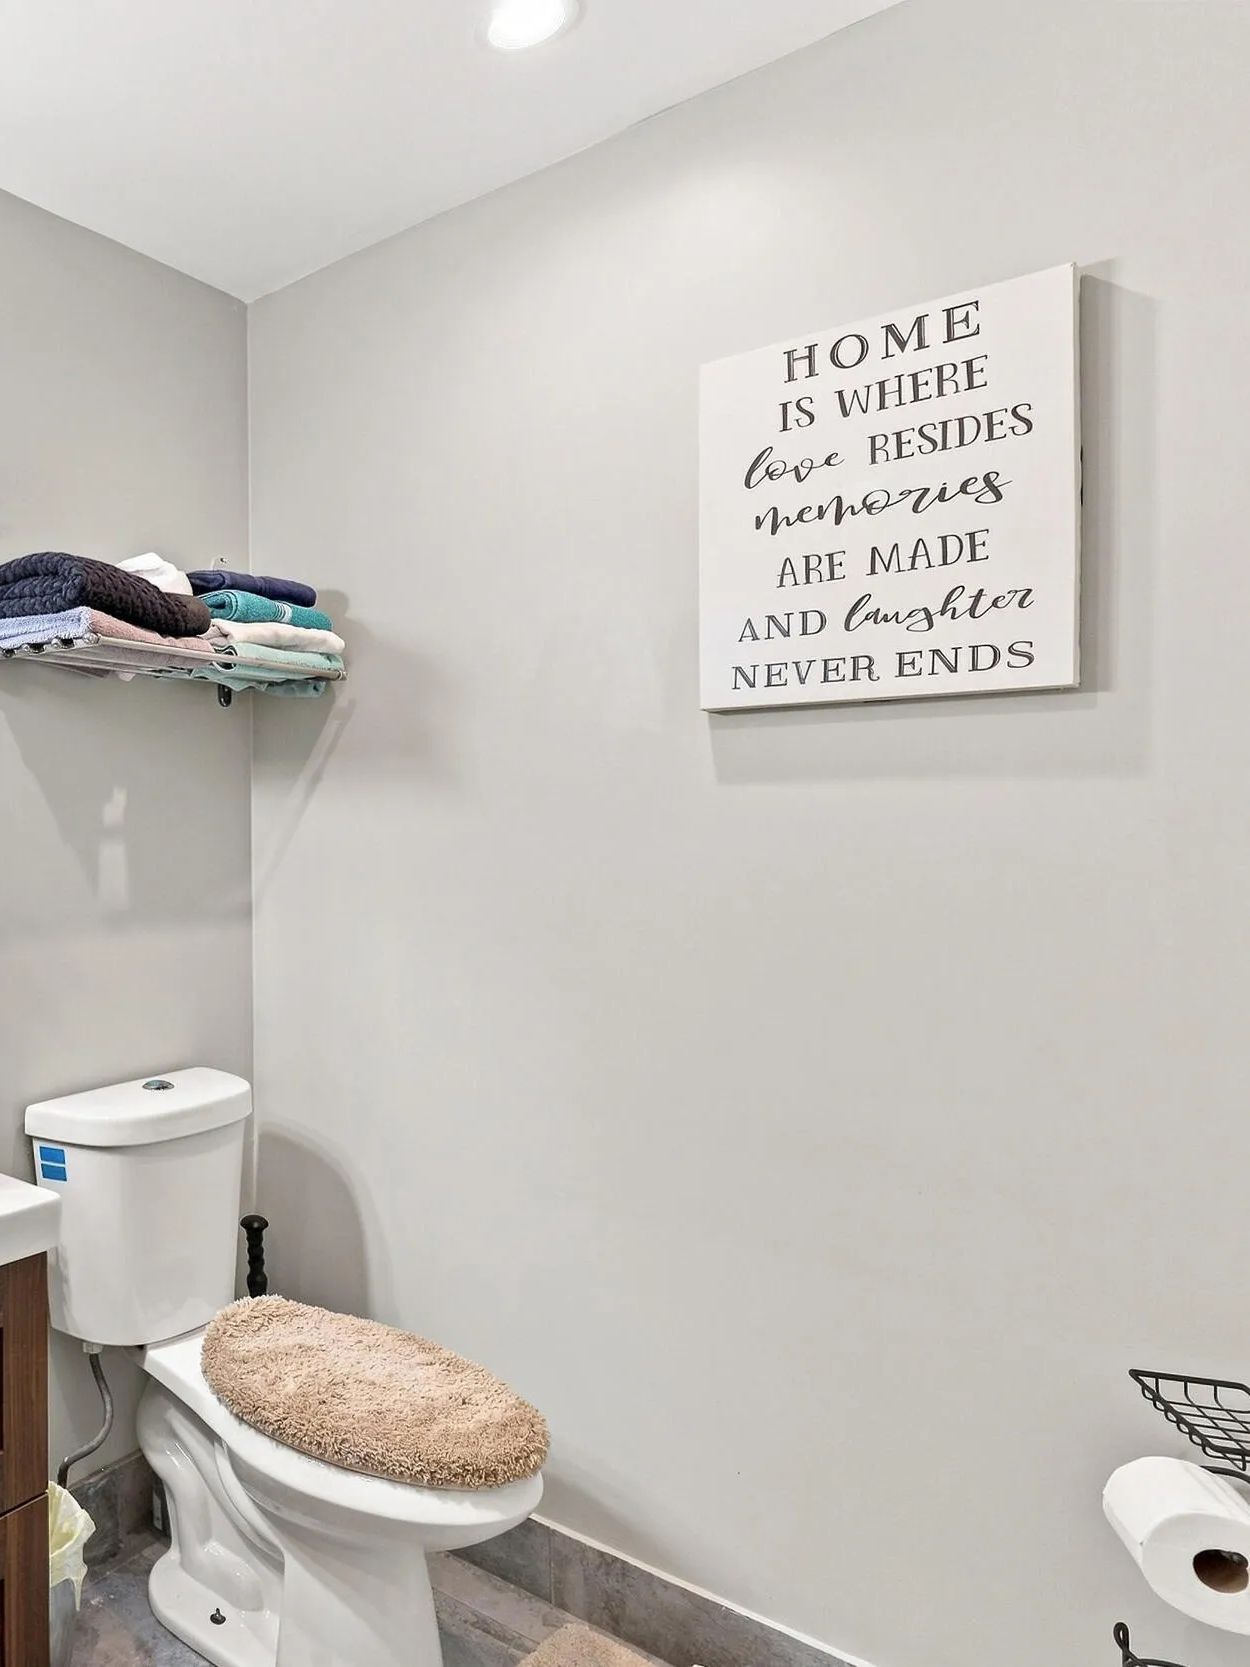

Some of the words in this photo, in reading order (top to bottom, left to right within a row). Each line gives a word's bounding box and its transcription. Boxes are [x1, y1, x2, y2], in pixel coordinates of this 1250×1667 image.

[783, 300, 981, 383] HOME
[778, 396, 816, 432] IS
[834, 354, 989, 418] WHERE
[744, 446, 844, 489] love
[868, 403, 1034, 465] RESIDES
[754, 470, 1013, 536] memories
[776, 550, 847, 588] ARE
[866, 528, 990, 576] MADE
[738, 608, 828, 643] AND
[843, 584, 1035, 632] laughter
[732, 654, 880, 690] NEVER
[894, 640, 1036, 678] ENDS
